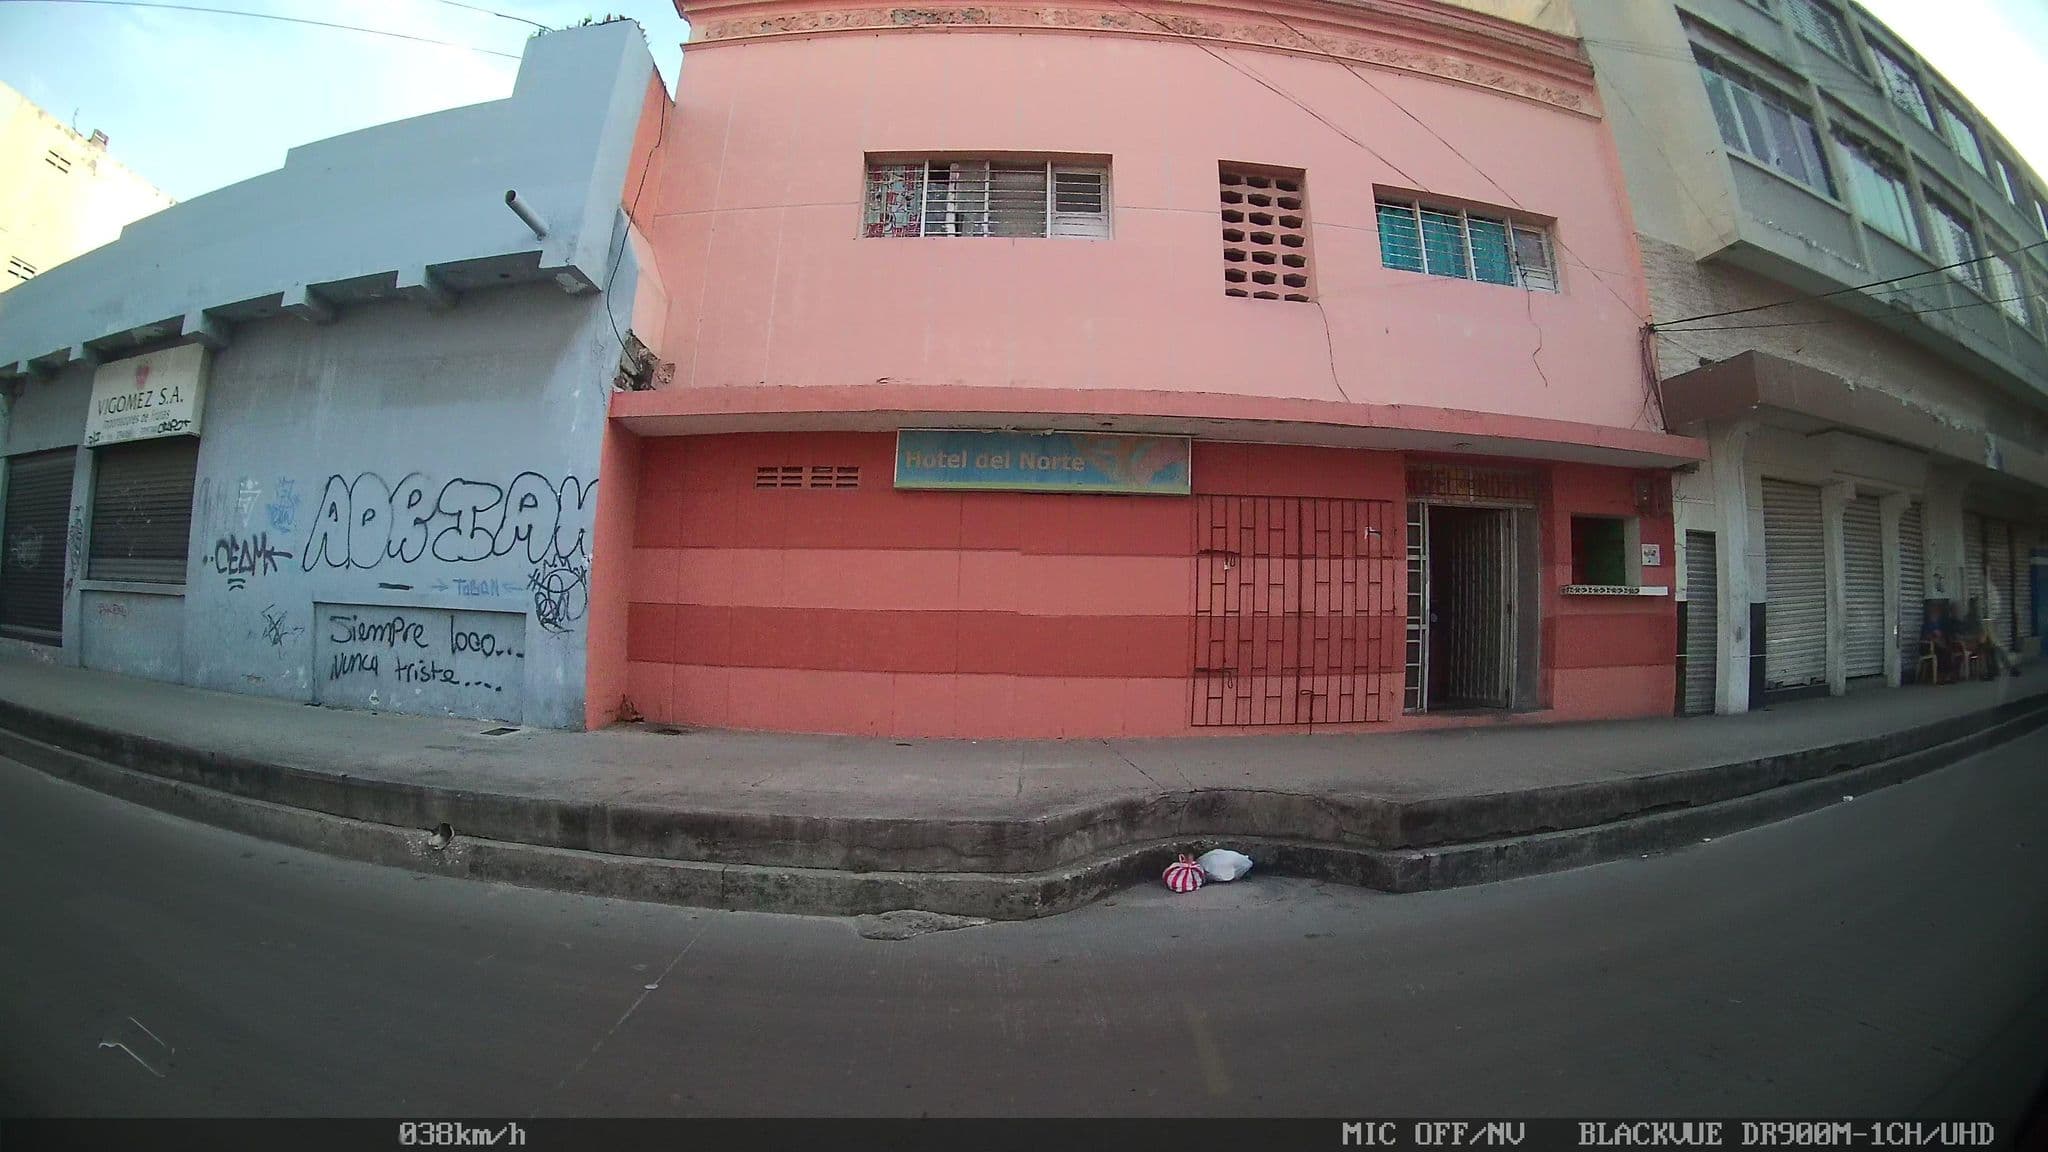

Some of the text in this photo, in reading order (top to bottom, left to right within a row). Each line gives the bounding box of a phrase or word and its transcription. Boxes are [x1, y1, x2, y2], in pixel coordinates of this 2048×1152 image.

[98, 390, 153, 416] VIGOMEZ
[158, 385, 184, 405] S.A.
[905, 450, 1086, 472] Hotel del Norte
